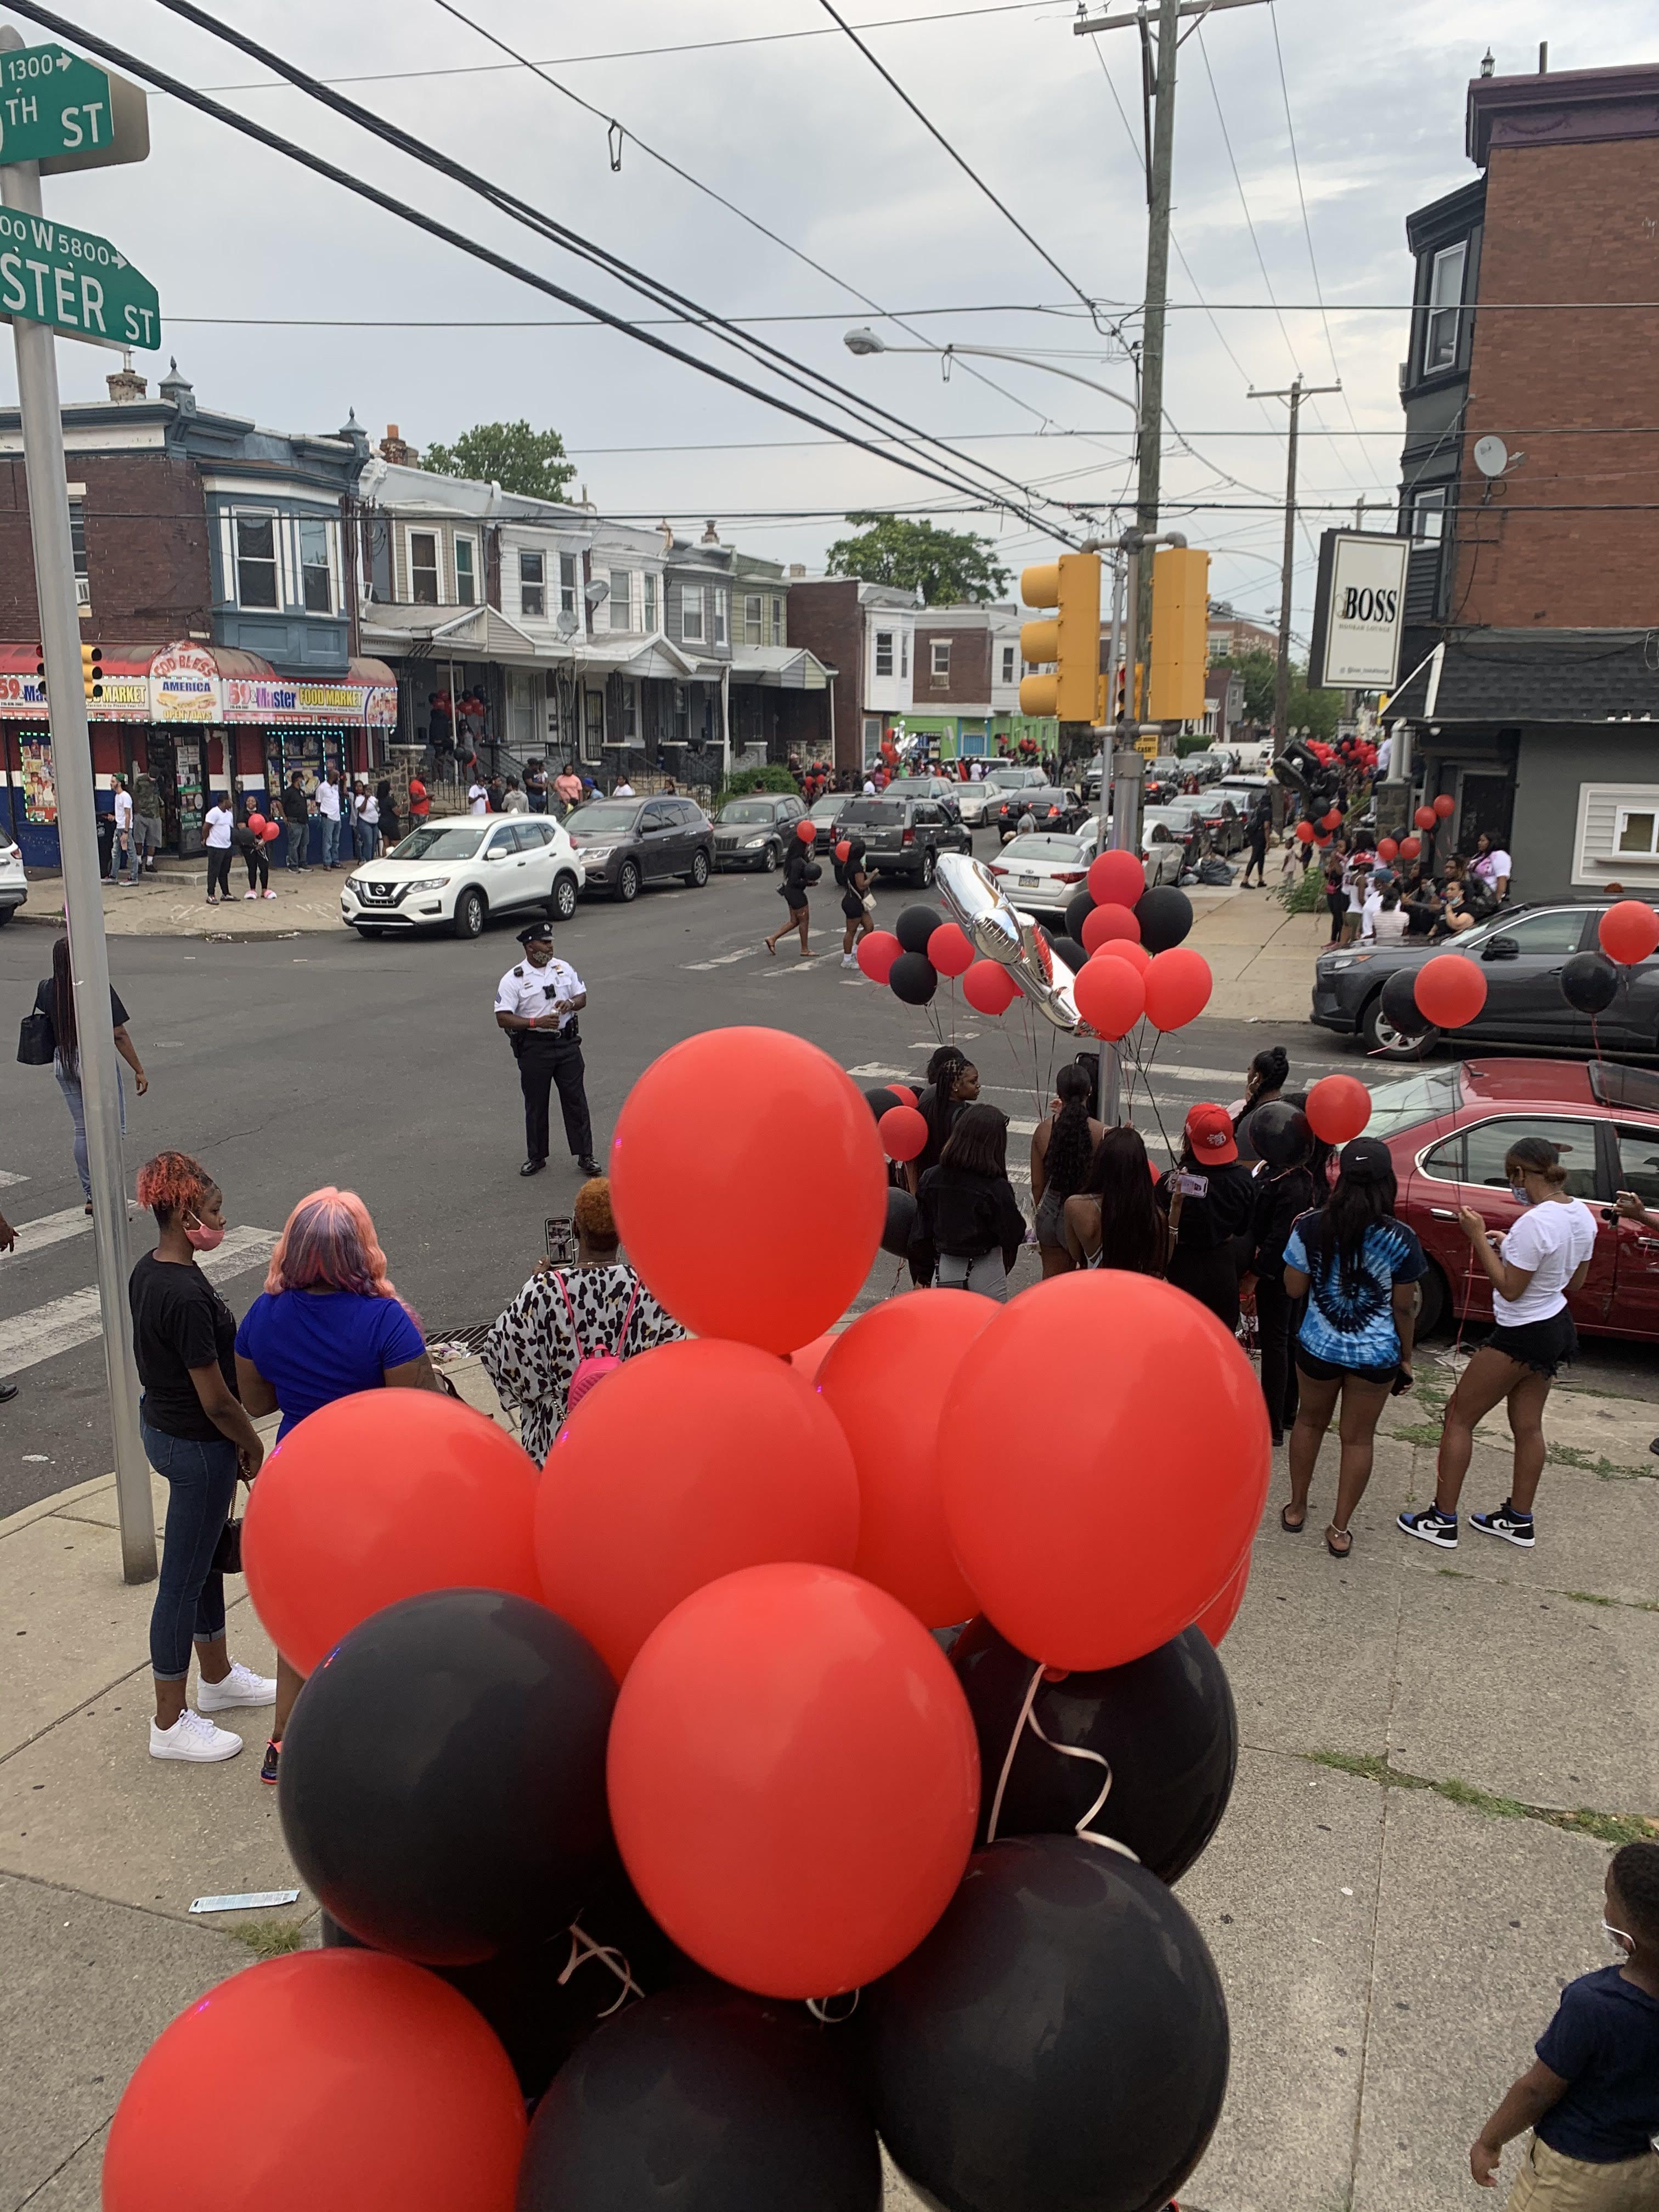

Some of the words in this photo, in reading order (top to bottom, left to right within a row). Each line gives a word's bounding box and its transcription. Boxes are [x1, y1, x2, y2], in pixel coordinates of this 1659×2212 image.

[8, 54, 53, 81] 1300
[61, 102, 103, 147] ST
[31, 219, 53, 252] W
[58, 233, 109, 266] 5800
[0, 252, 106, 332] STER
[124, 304, 154, 343] ST
[1346, 587, 1397, 623] BOSS
[153, 658, 177, 677] GOD
[179, 655, 218, 677] BLESS
[0, 678, 20, 700] 59
[24, 685, 48, 703] Ma
[102, 685, 146, 704] MARKET
[163, 682, 211, 692] AMERICA
[229, 682, 251, 704] 59
[250, 690, 257, 703] &
[256, 687, 296, 709] Master
[299, 687, 325, 706] FOOD
[325, 689, 363, 708] MARKET
[163, 710, 185, 720] OPEN
[191, 710, 213, 721] DAYS
